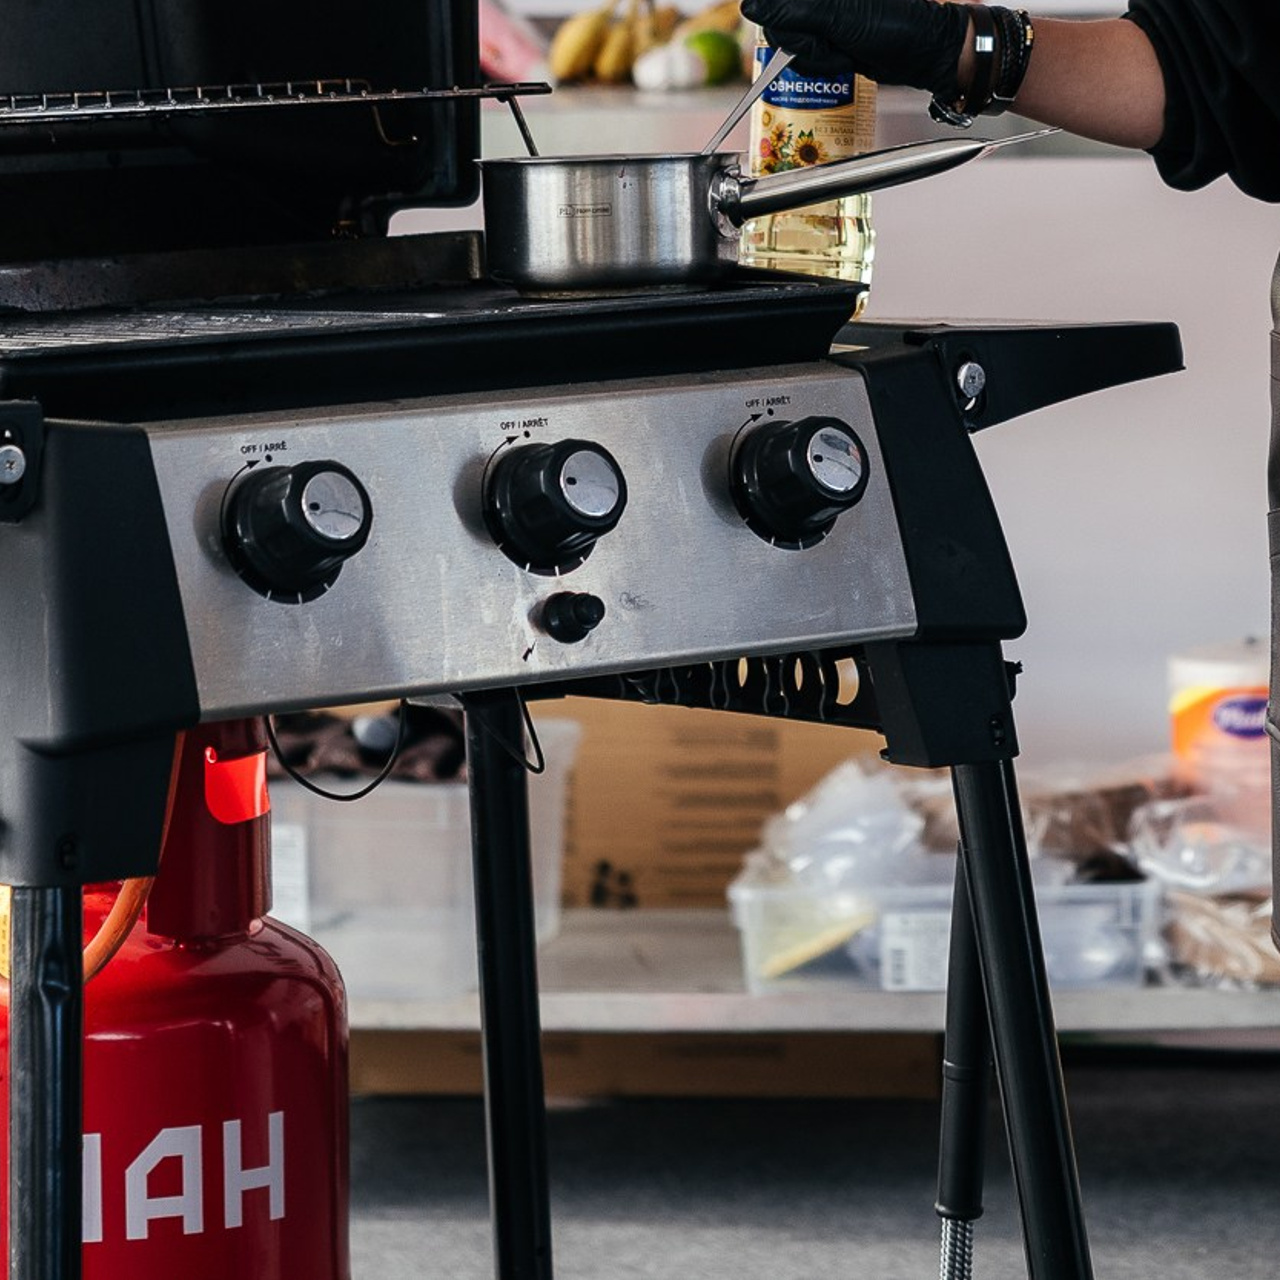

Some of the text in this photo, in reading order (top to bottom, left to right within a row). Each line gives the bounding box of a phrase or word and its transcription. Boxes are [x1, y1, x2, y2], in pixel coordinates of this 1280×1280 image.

[745, 399, 760, 409] OFF
[500, 421, 515, 431] OFF
[241, 444, 257, 455] OFF
